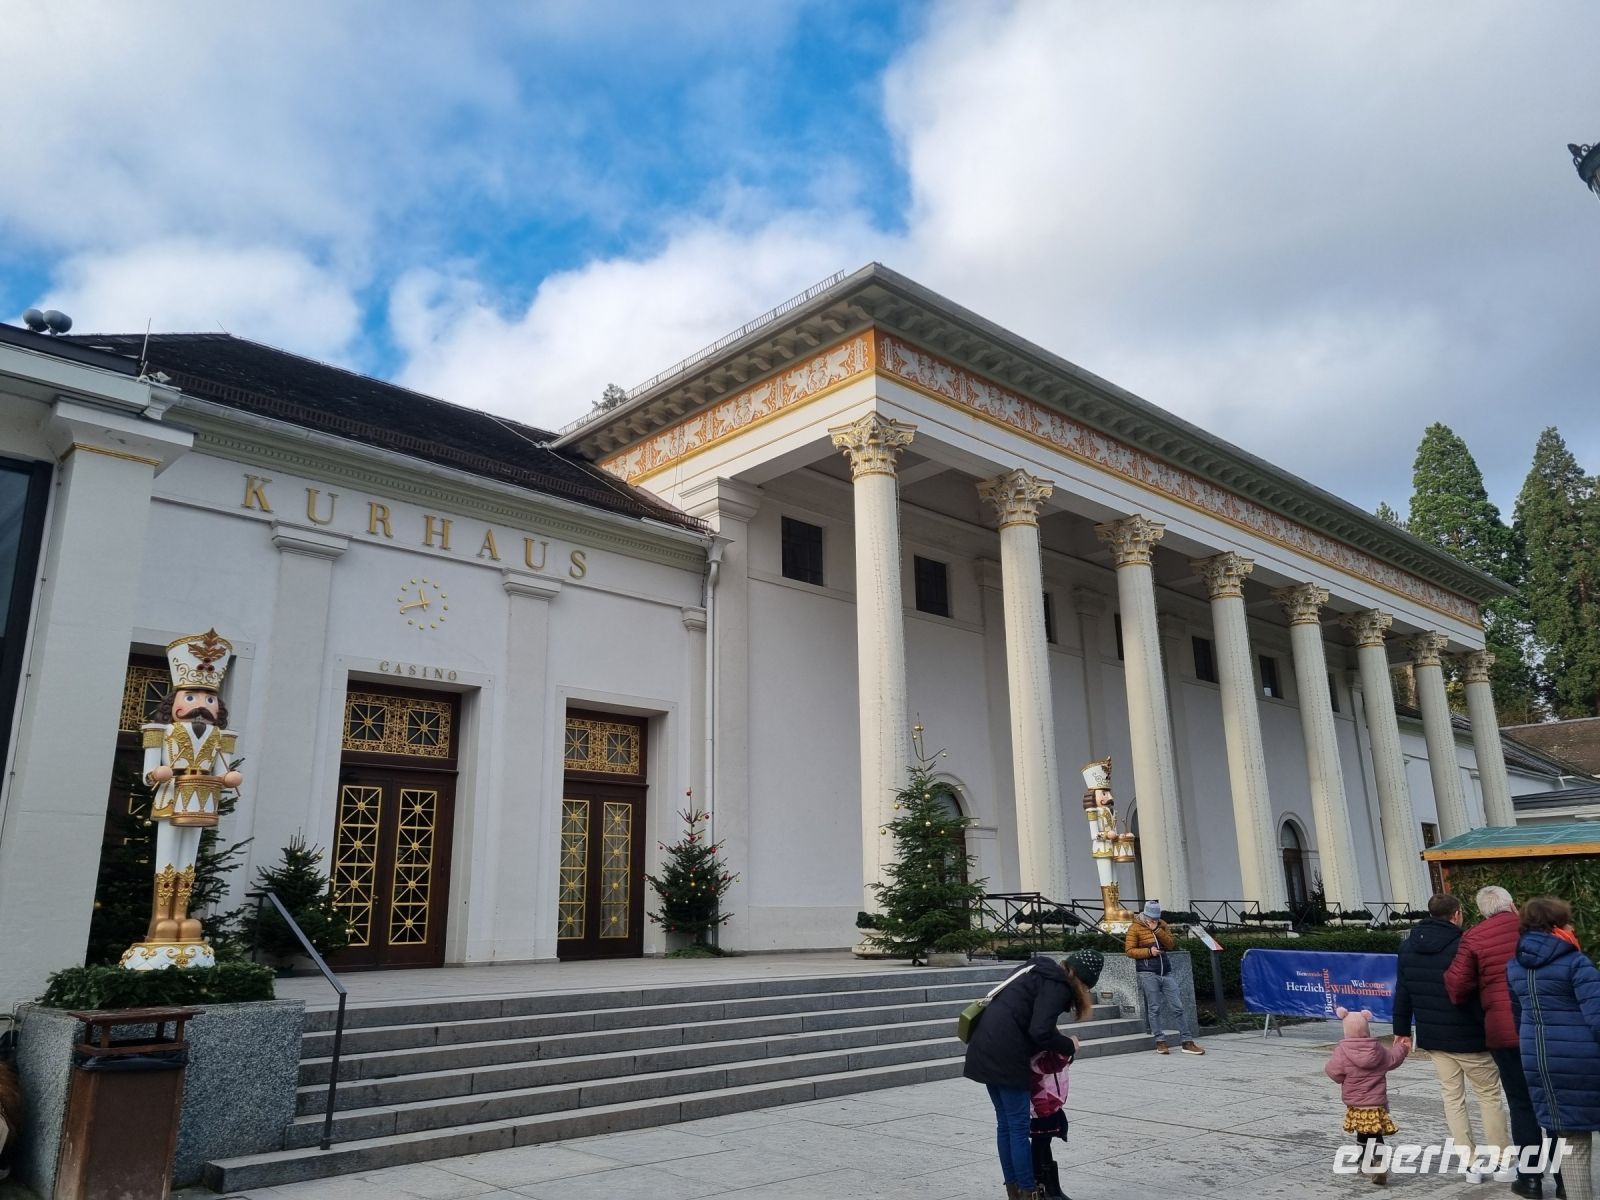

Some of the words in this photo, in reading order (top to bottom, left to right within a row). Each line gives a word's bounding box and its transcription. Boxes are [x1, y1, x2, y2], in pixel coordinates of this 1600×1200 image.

[240, 473, 588, 580] KURHAUS
[380, 660, 457, 681] CASINO
[1286, 981, 1325, 993] Herzlich
[1330, 984, 1392, 997] Willkommen
[1351, 979, 1385, 989] Welcome
